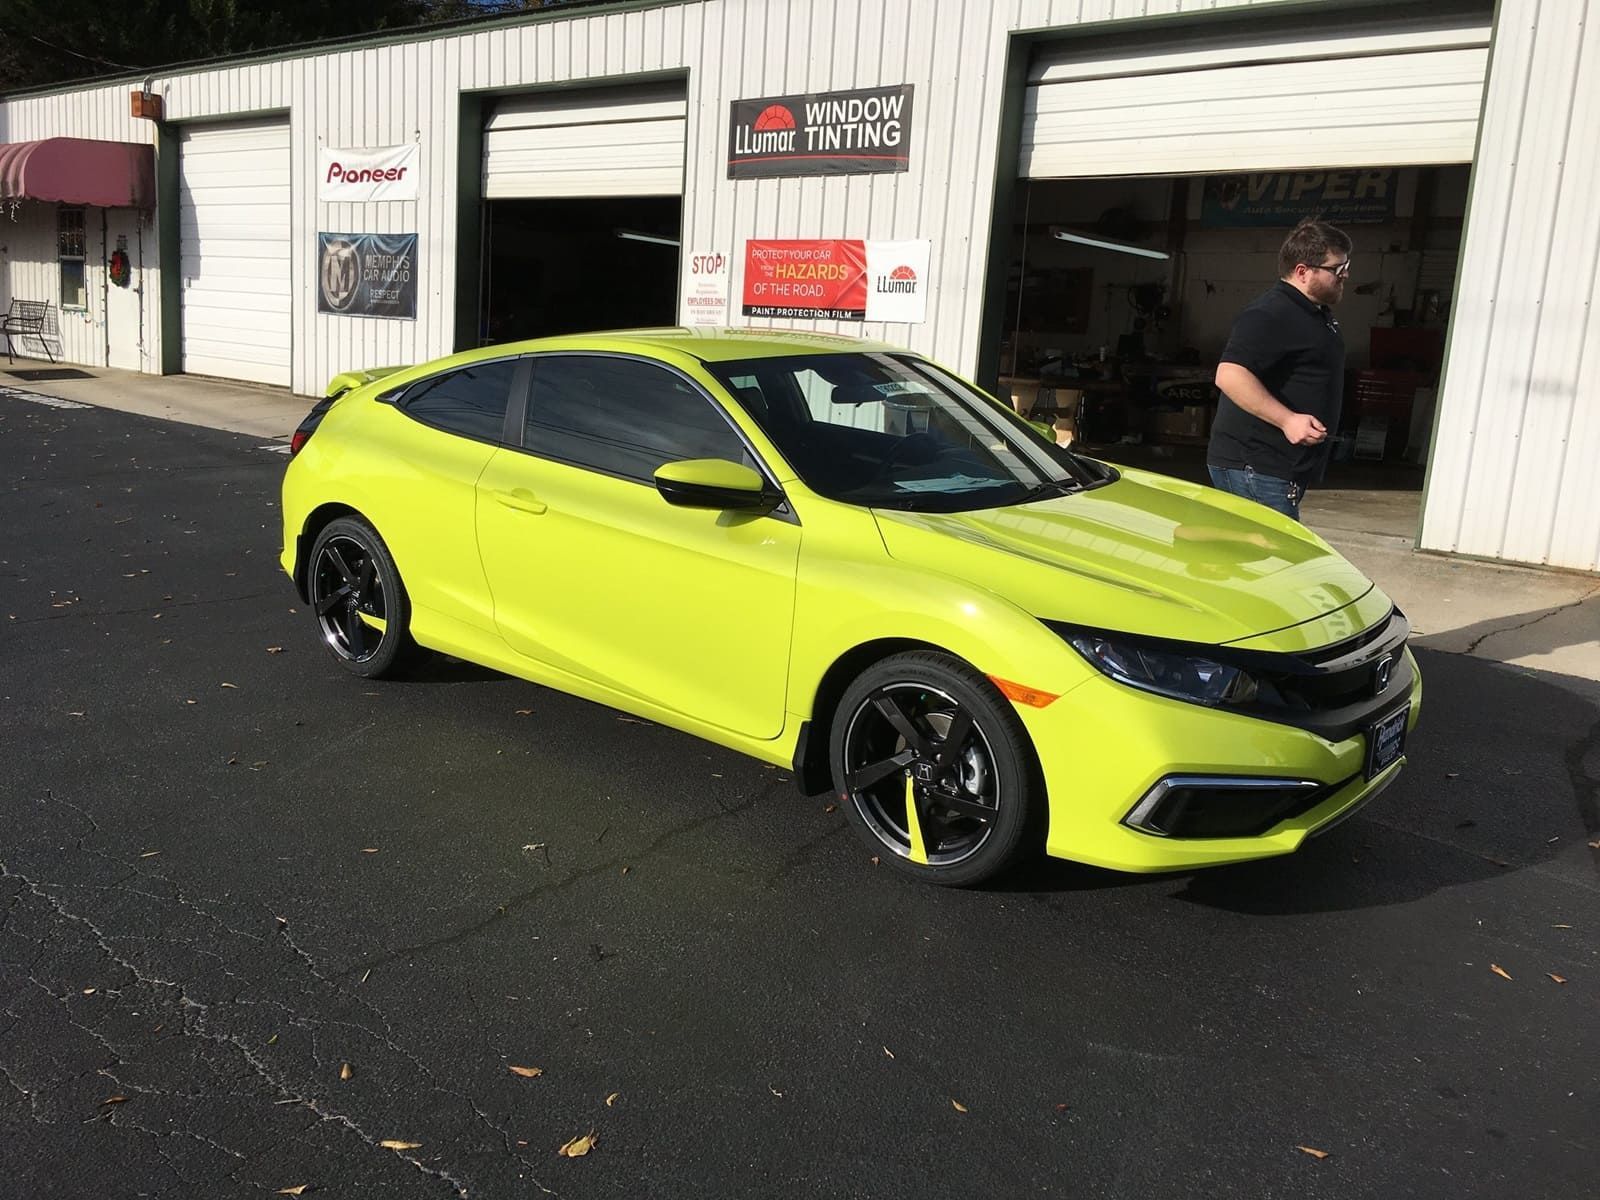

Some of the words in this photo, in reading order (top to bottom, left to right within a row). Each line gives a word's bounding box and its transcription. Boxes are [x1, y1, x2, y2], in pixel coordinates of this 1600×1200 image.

[805, 95, 904, 125] WINDOW
[735, 125, 796, 154] LLumar
[804, 120, 901, 151] TINTING
[327, 162, 407, 183] Pioneer
[1248, 169, 1389, 200] VIPER
[366, 255, 410, 269] MEMPHIS
[752, 249, 787, 259] PROTECT
[789, 250, 812, 259] YOUR
[813, 250, 832, 259] CAR
[692, 256, 726, 274] STOP!
[775, 263, 849, 280] HAZARDS
[363, 269, 379, 281] CAR
[381, 270, 410, 282] AUDIO
[877, 275, 917, 293] LLumar
[370, 289, 400, 300] RESPECT
[753, 283, 768, 295] OF
[770, 283, 790, 295] THE
[792, 284, 826, 297] ROAD.
[752, 307, 775, 315] PAINT
[777, 308, 830, 317] PROTECTION
[832, 310, 852, 318] FILM
